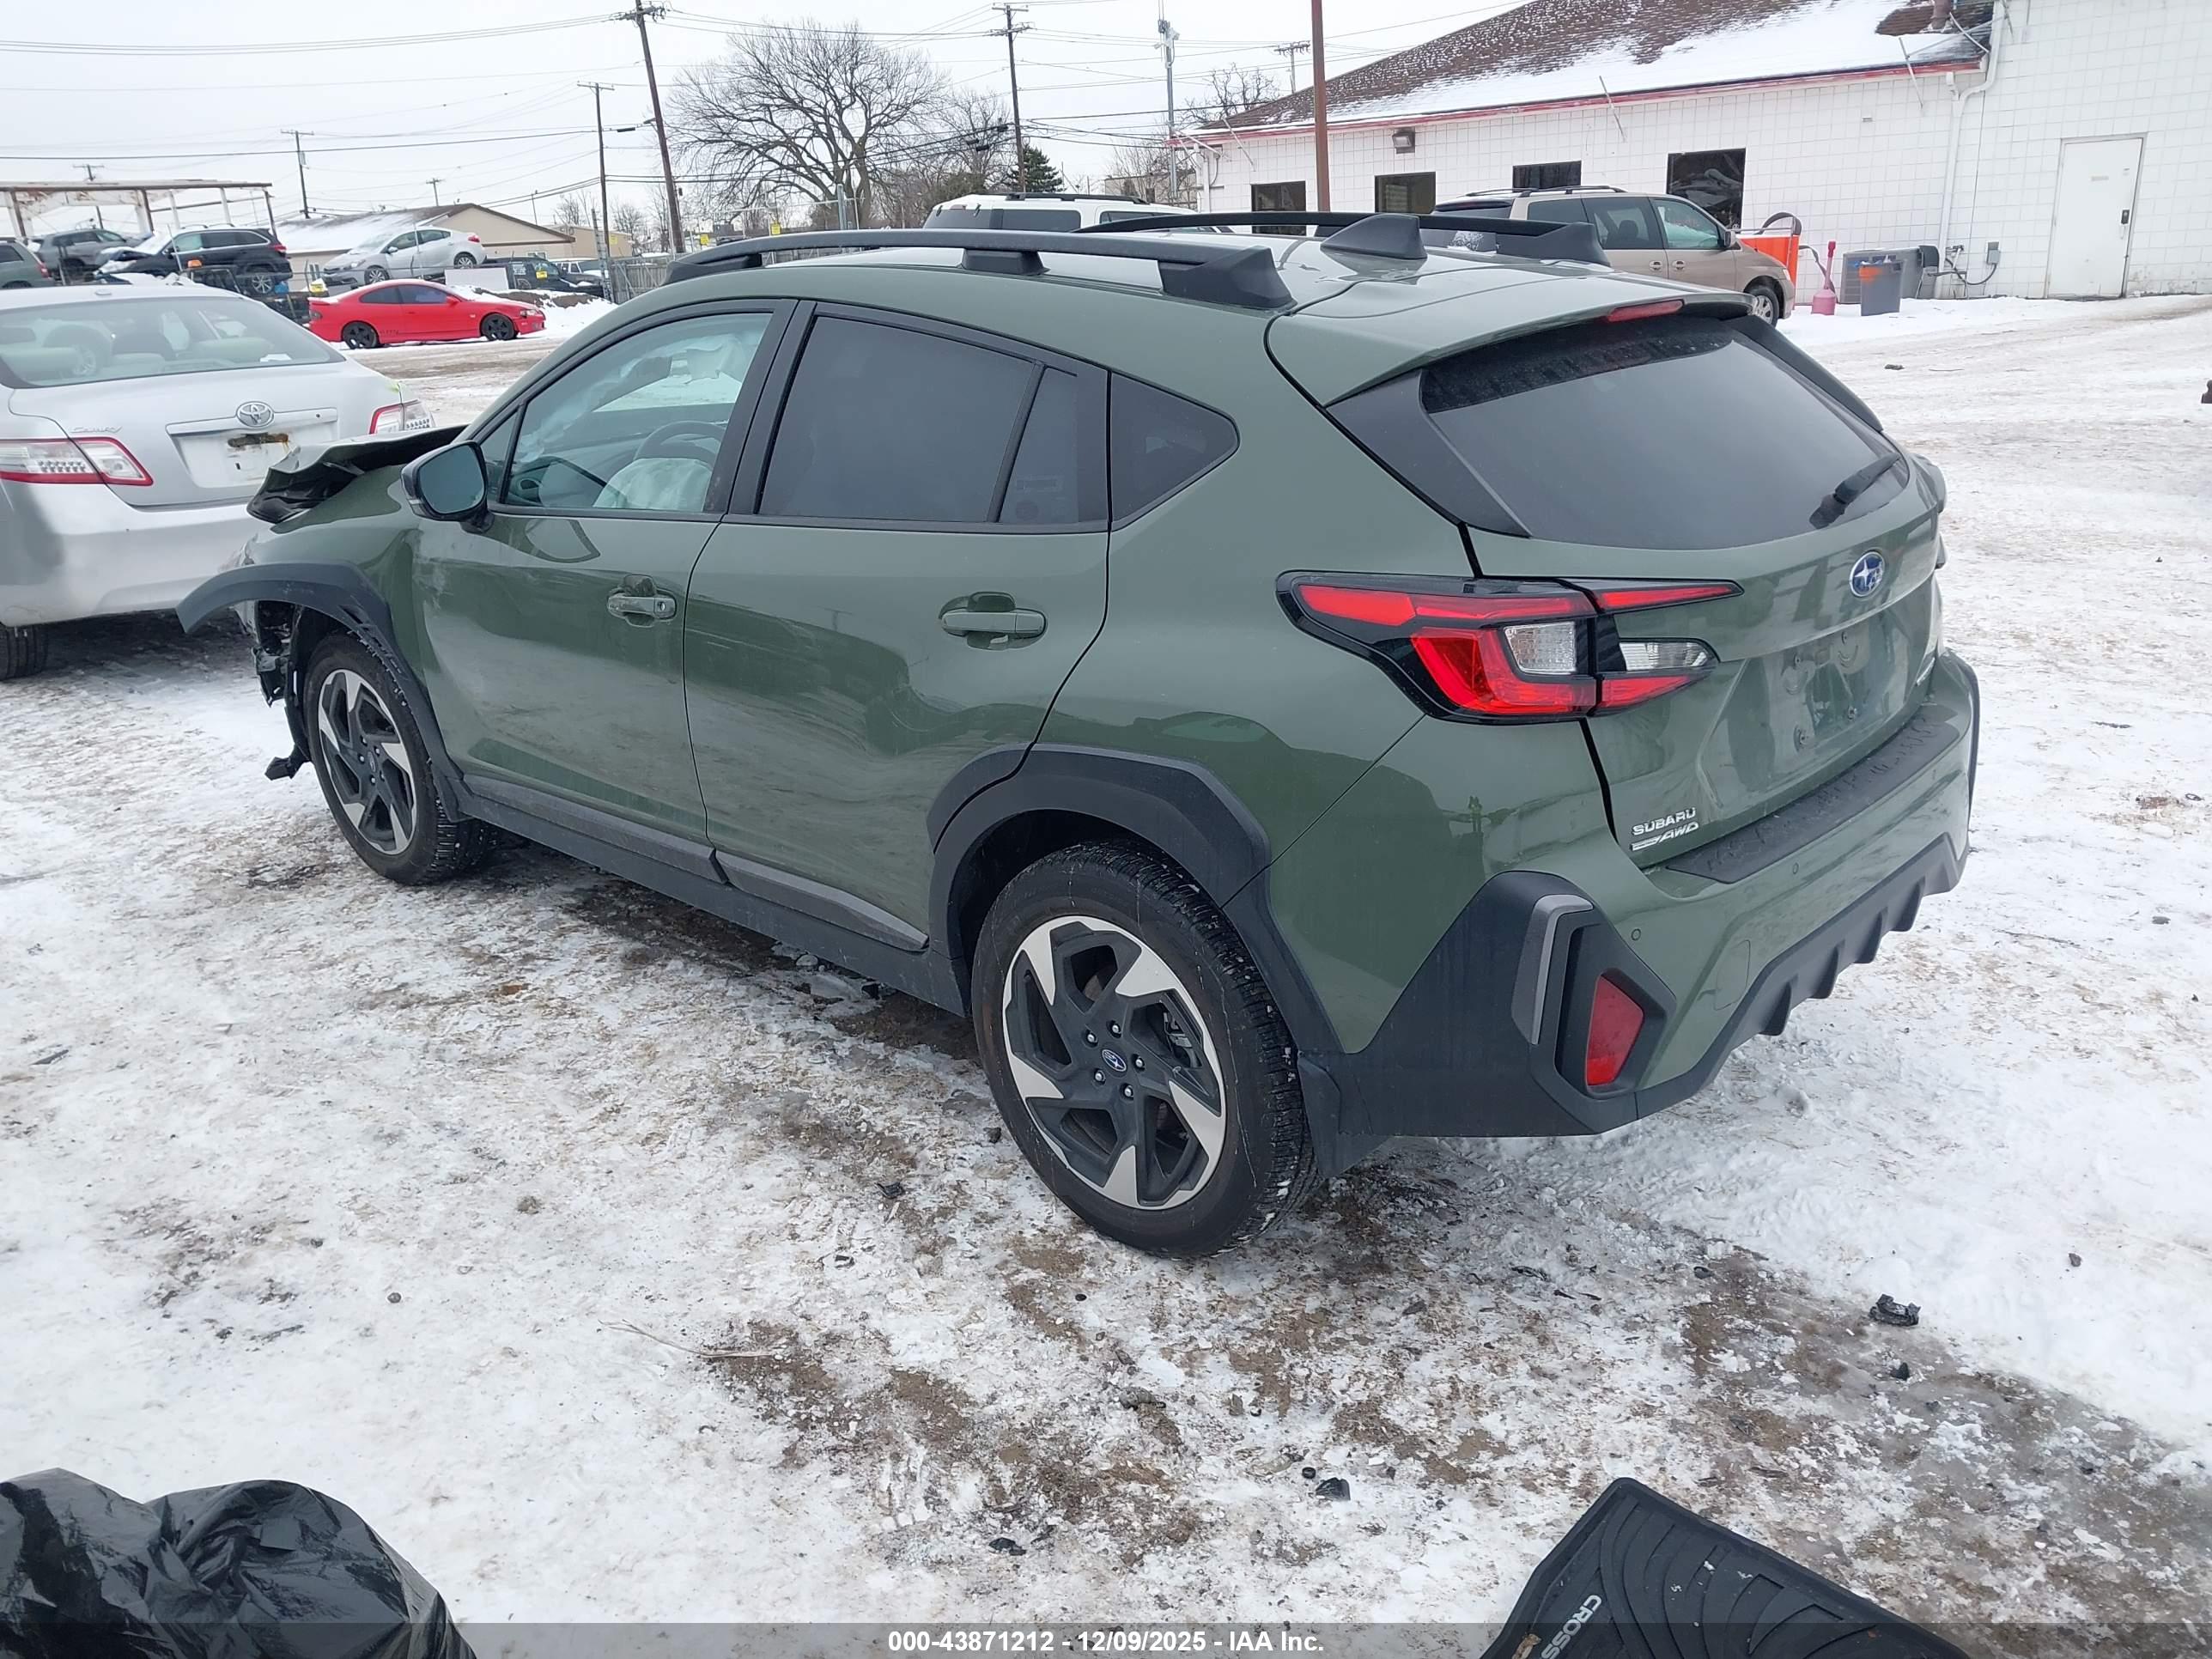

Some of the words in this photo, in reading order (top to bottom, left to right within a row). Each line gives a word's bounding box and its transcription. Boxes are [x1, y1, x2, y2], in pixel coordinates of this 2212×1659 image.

[1632, 807, 1696, 836] SUBARU
[1659, 821, 1699, 843] AWD
[1540, 1595, 1602, 1659] CROSS
